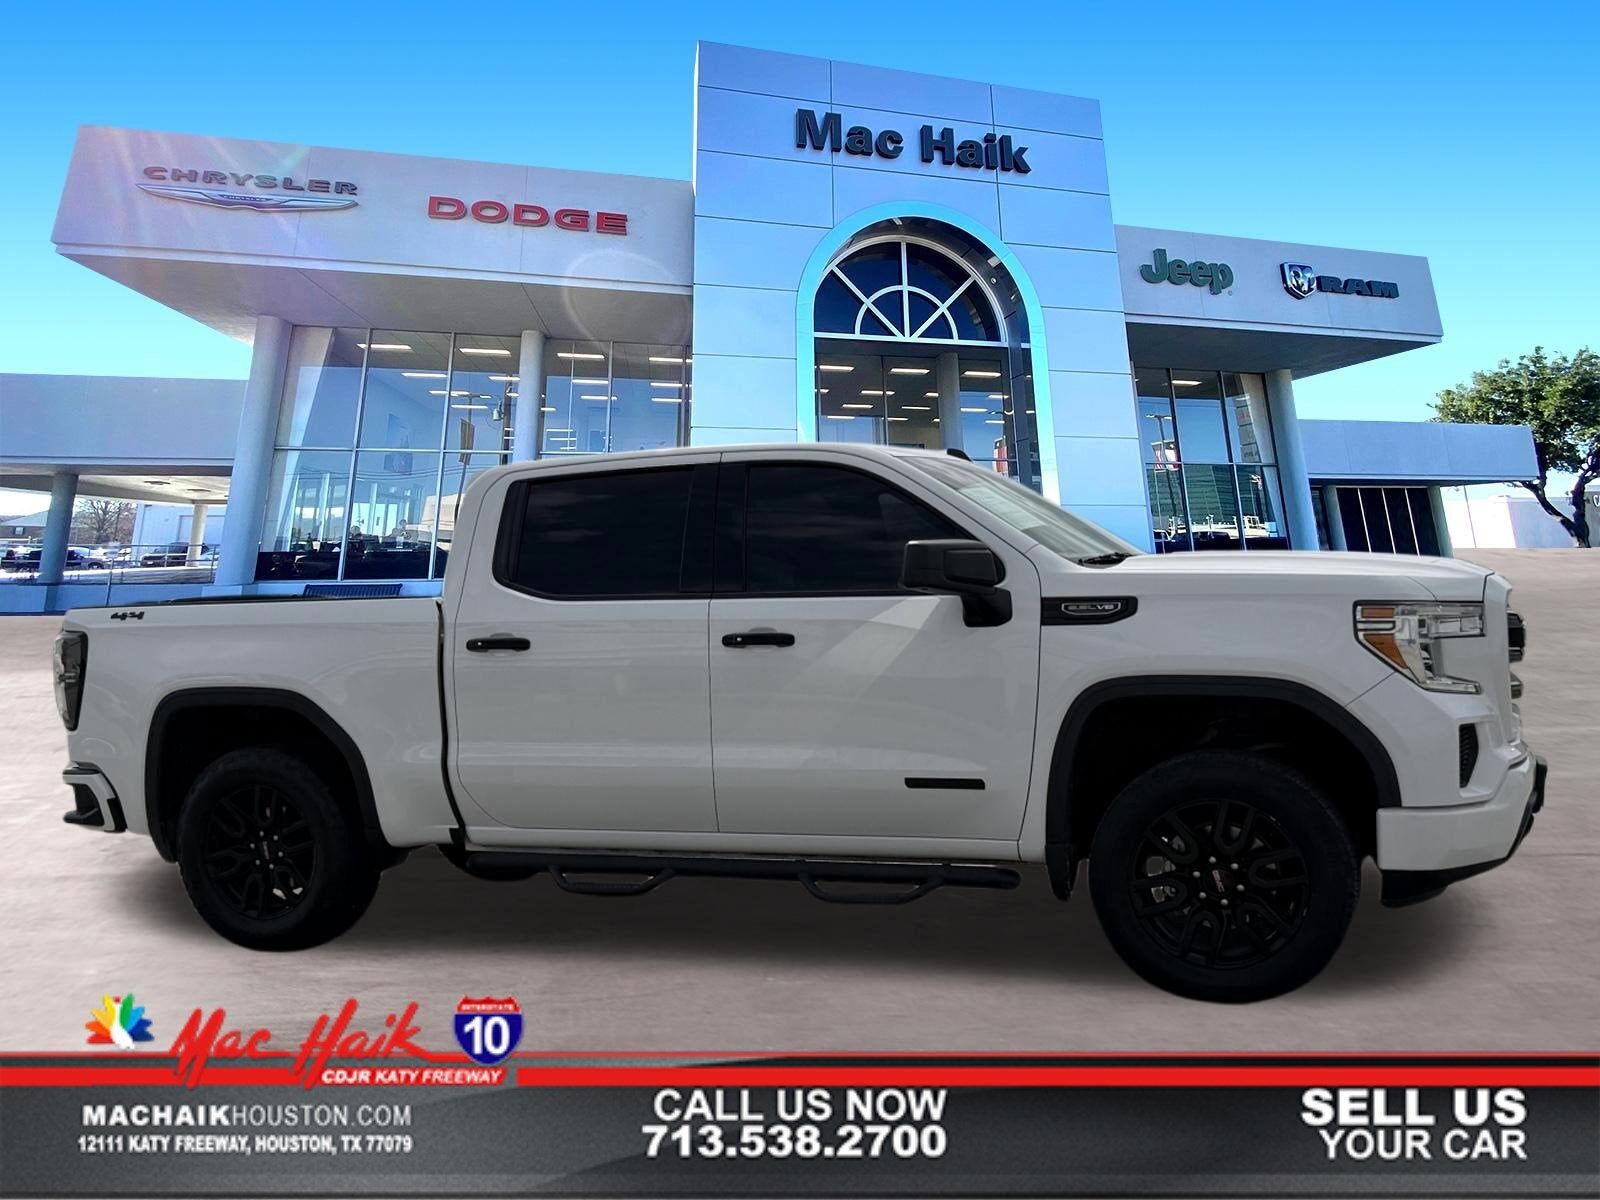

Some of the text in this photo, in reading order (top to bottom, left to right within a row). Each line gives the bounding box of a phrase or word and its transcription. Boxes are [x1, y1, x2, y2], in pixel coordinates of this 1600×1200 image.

[796, 108, 1032, 174] Mac Haik
[143, 166, 358, 196] CHRYSLER
[427, 195, 628, 236] DODGE
[1140, 248, 1234, 295] Jeep
[1315, 275, 1399, 299] RAM
